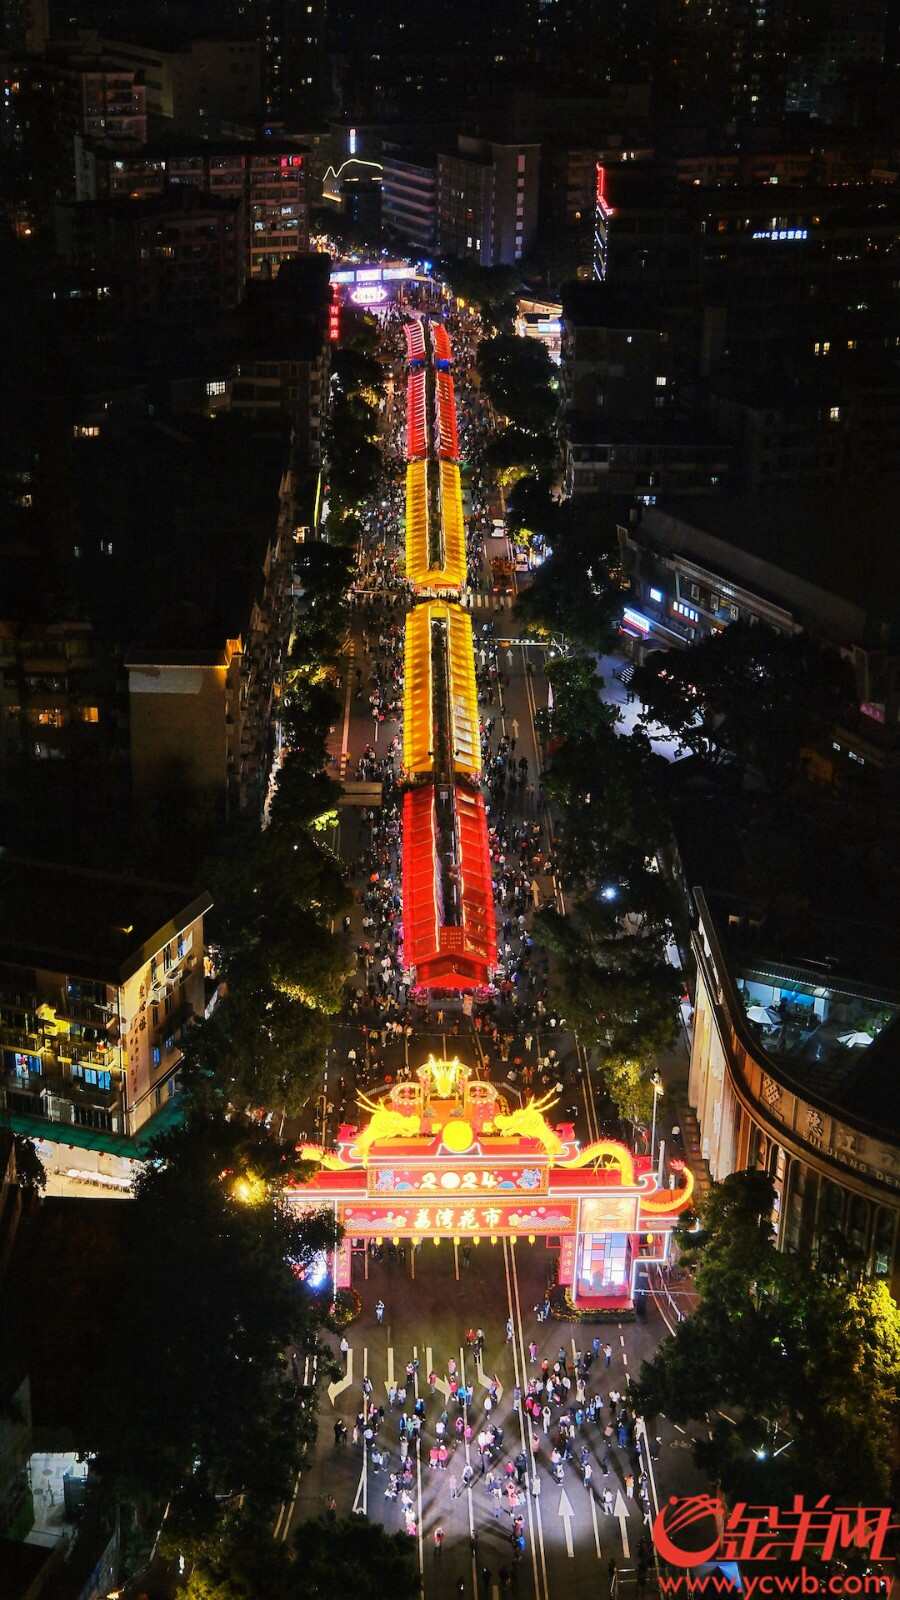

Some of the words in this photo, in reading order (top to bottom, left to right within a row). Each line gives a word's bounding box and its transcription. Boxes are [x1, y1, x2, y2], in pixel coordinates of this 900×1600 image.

[420, 1171, 498, 1190] 2024
[413, 1207, 504, 1230] 荔湾花市
